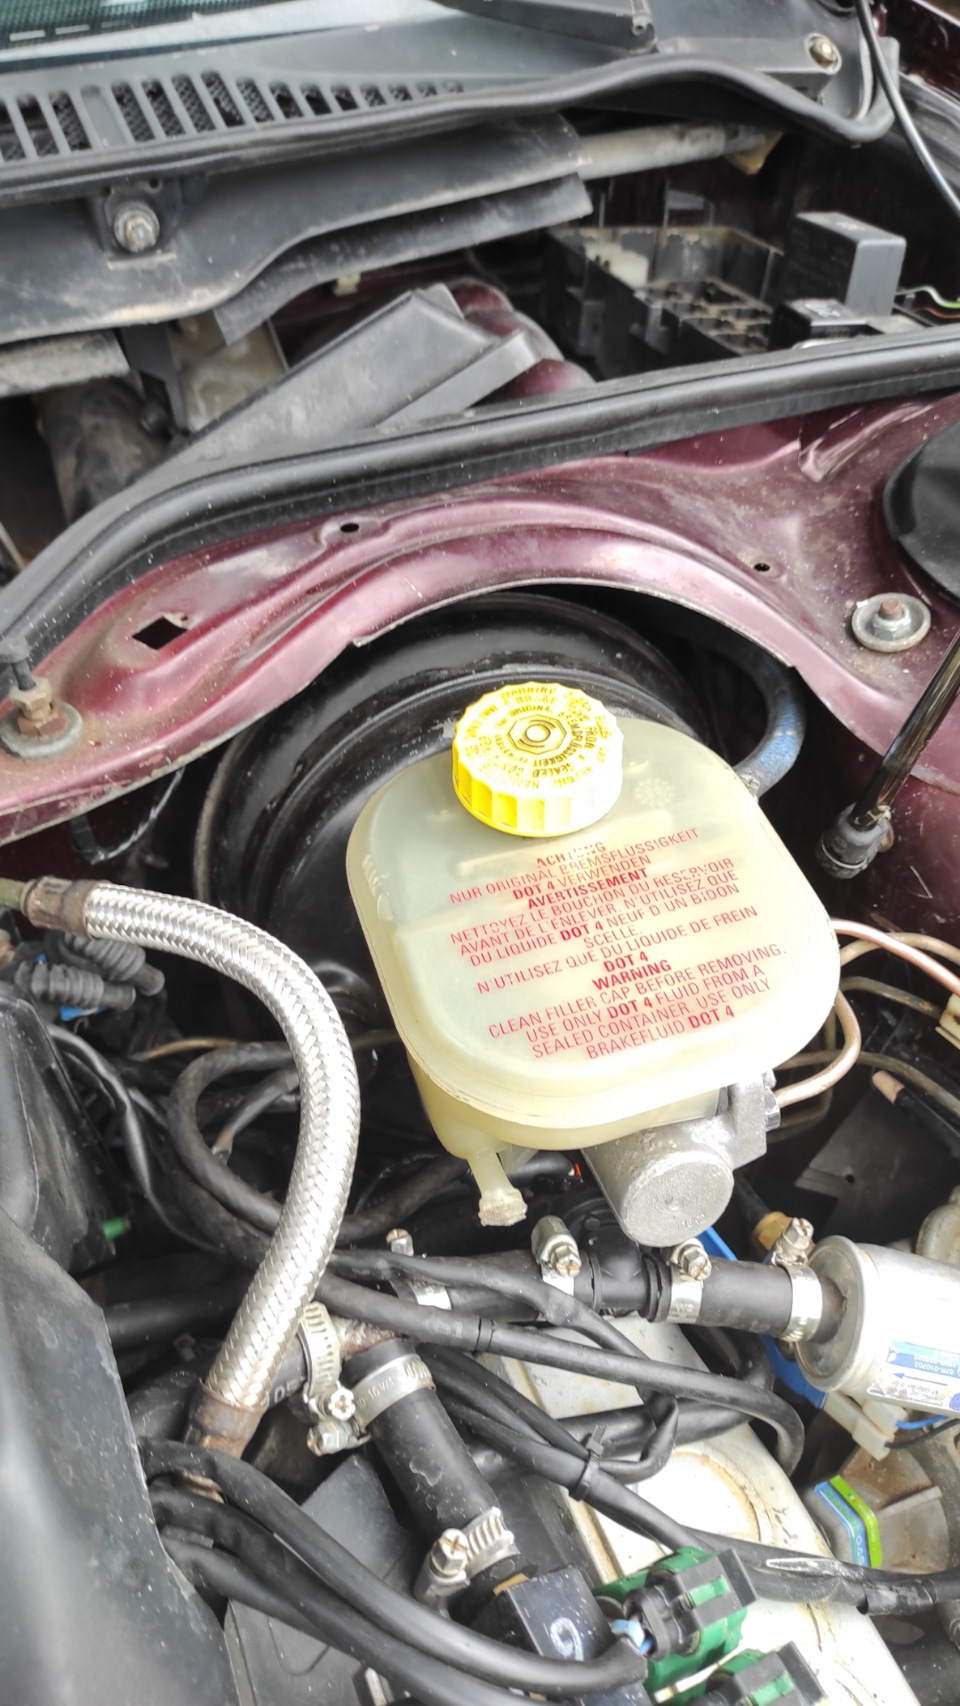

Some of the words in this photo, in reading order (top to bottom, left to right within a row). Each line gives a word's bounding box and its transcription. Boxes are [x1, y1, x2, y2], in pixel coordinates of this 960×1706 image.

[449, 887, 482, 904] NUR
[486, 868, 557, 894] ORIGINAL
[559, 827, 699, 875] BREMSFLÜSSIGKEIT
[512, 884, 542, 900] DOT
[547, 880, 555, 891] 4
[558, 854, 651, 887] VERWENDEN
[528, 867, 648, 910] AVERTISSEMENT
[536, 842, 606, 868] ACHTG
[450, 914, 526, 944] NETTOYEZ
[530, 908, 549, 922] LE
[551, 888, 626, 917] BOUCHON
[629, 882, 650, 895] DU
[653, 858, 735, 888] RESERVOIR
[460, 932, 511, 956] AVANT
[514, 926, 536, 940] DE
[624, 878, 703, 909] N'UTILISEZ
[707, 870, 739, 887] QUE
[470, 952, 493, 967] DU
[496, 933, 557, 960] LIQUIDE
[560, 924, 590, 941] DOT
[595, 921, 604, 931] 4
[606, 907, 646, 928] NEUF
[649, 897, 688, 916] D'UN
[691, 882, 740, 905] BIDON
[476, 960, 563, 994] N'UTILISEZ
[566, 951, 599, 968] QUE
[600, 943, 623, 959] DU
[626, 925, 688, 951] LIQUIDE
[689, 919, 711, 934] DE
[713, 906, 758, 927] FREIN
[592, 959, 672, 991] WARNING
[603, 955, 635, 972] DOT
[639, 951, 648, 962] 4
[488, 1012, 542, 1038] CLEAN
[545, 996, 598, 1021] FILLER
[600, 987, 630, 1005] CAP
[634, 967, 696, 995] BEFORE
[698, 943, 787, 977] REMOVING.
[526, 1022, 559, 1043] USE
[562, 1009, 602, 1032] ONLY
[607, 1000, 639, 1019] DOT
[644, 997, 653, 1009] 4
[655, 982, 700, 1005] FLUID
[703, 968, 749, 991] FROM
[753, 964, 765, 977] A
[532, 1029, 594, 1059] SEALED
[696, 990, 729, 1010] USE
[731, 978, 771, 999] ONLY
[586, 1020, 685, 1059] BRAKEFLUID
[688, 1008, 720, 1029] DOT
[725, 1005, 735, 1018] 4
